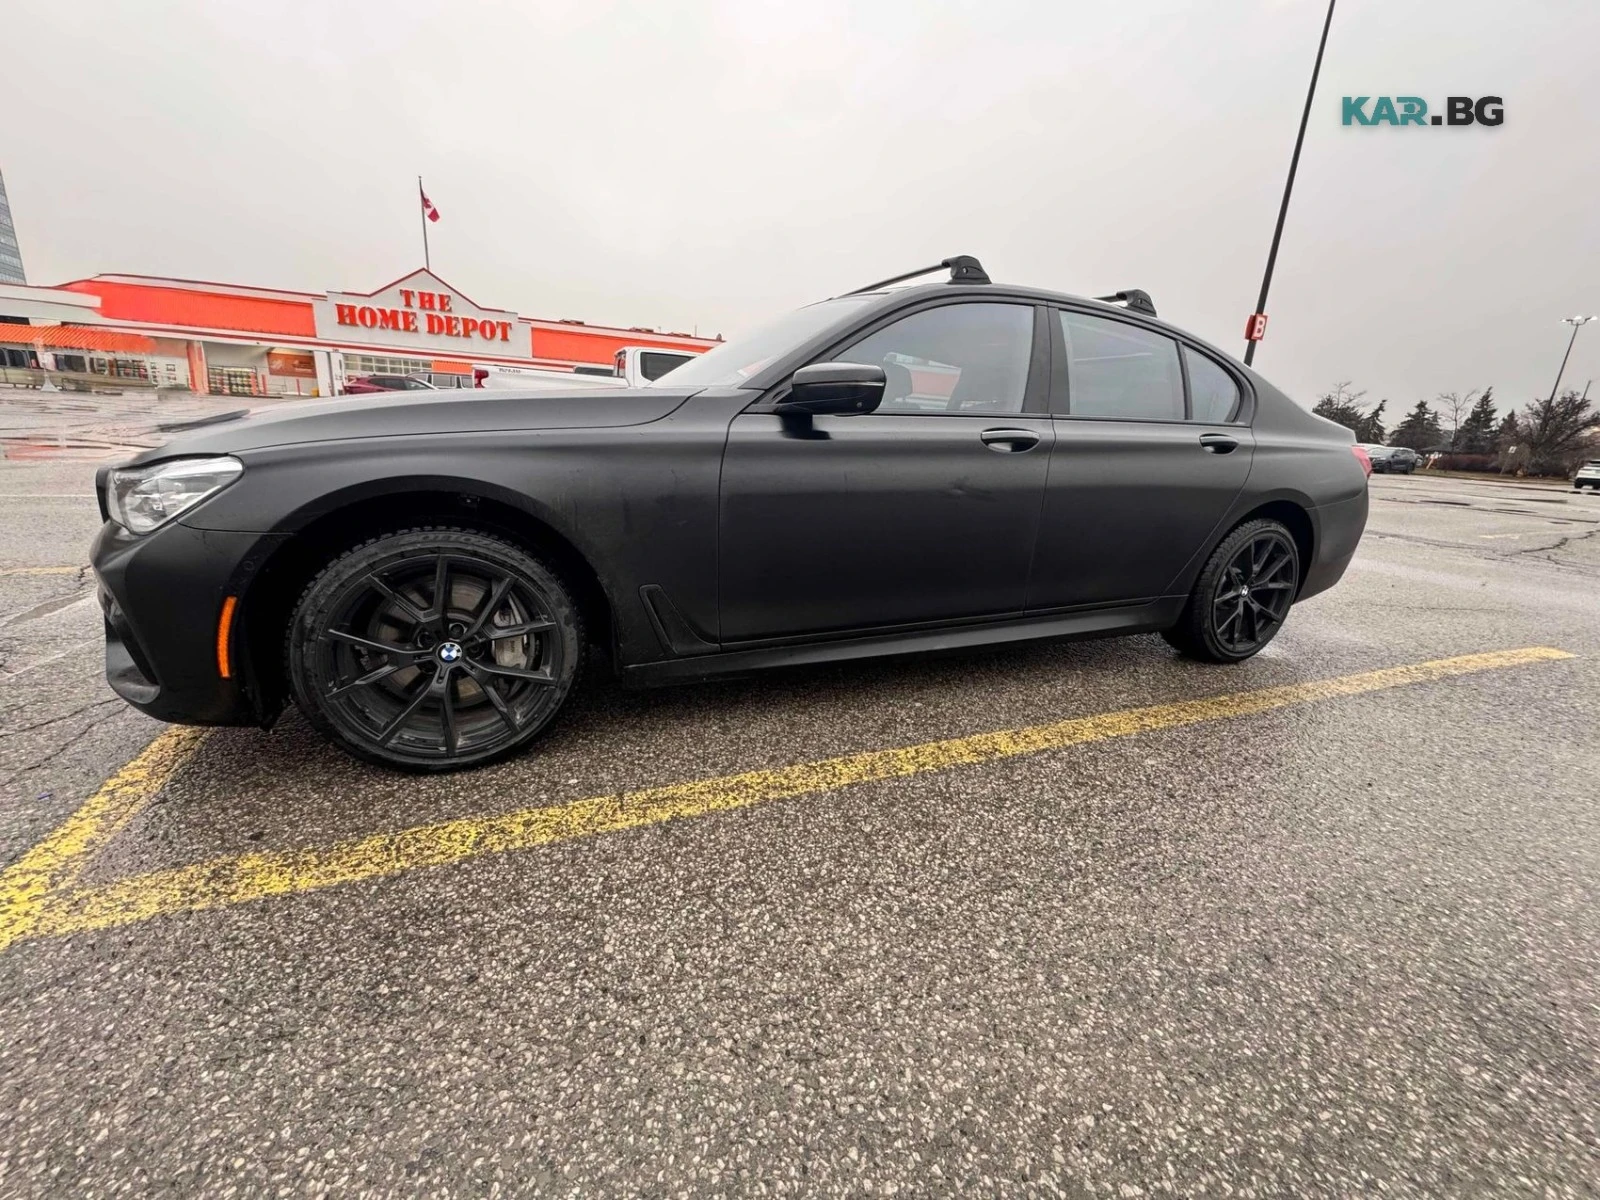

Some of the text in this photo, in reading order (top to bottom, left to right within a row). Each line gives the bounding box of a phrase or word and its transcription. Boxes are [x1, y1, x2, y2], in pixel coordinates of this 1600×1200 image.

[400, 289, 452, 312] THE
[335, 304, 512, 342] HOME DEPOT
[1253, 316, 1266, 338] B
